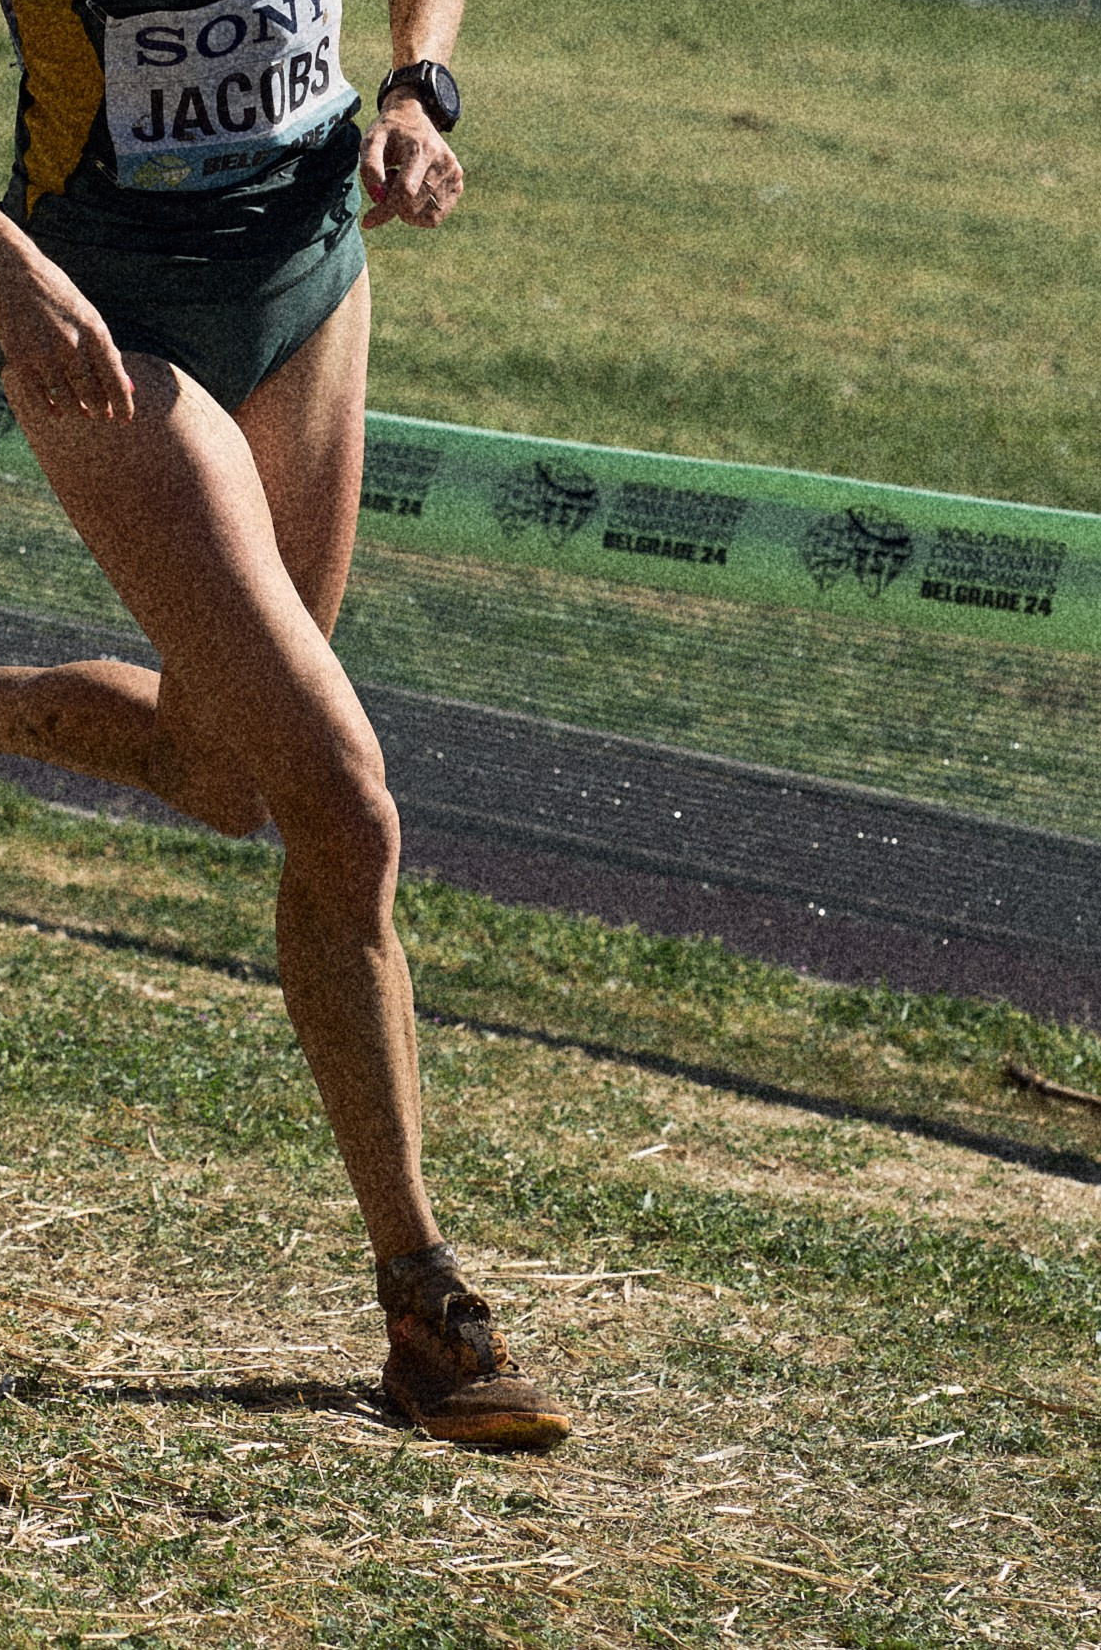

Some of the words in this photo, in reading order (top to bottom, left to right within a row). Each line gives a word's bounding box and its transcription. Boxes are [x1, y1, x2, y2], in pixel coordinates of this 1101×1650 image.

[131, 35, 331, 143] JACOBS
[202, 121, 325, 177] BELADE
[701, 545, 728, 565] 24
[920, 580, 1021, 612] BELGRADE
[1023, 595, 1053, 617] 24
